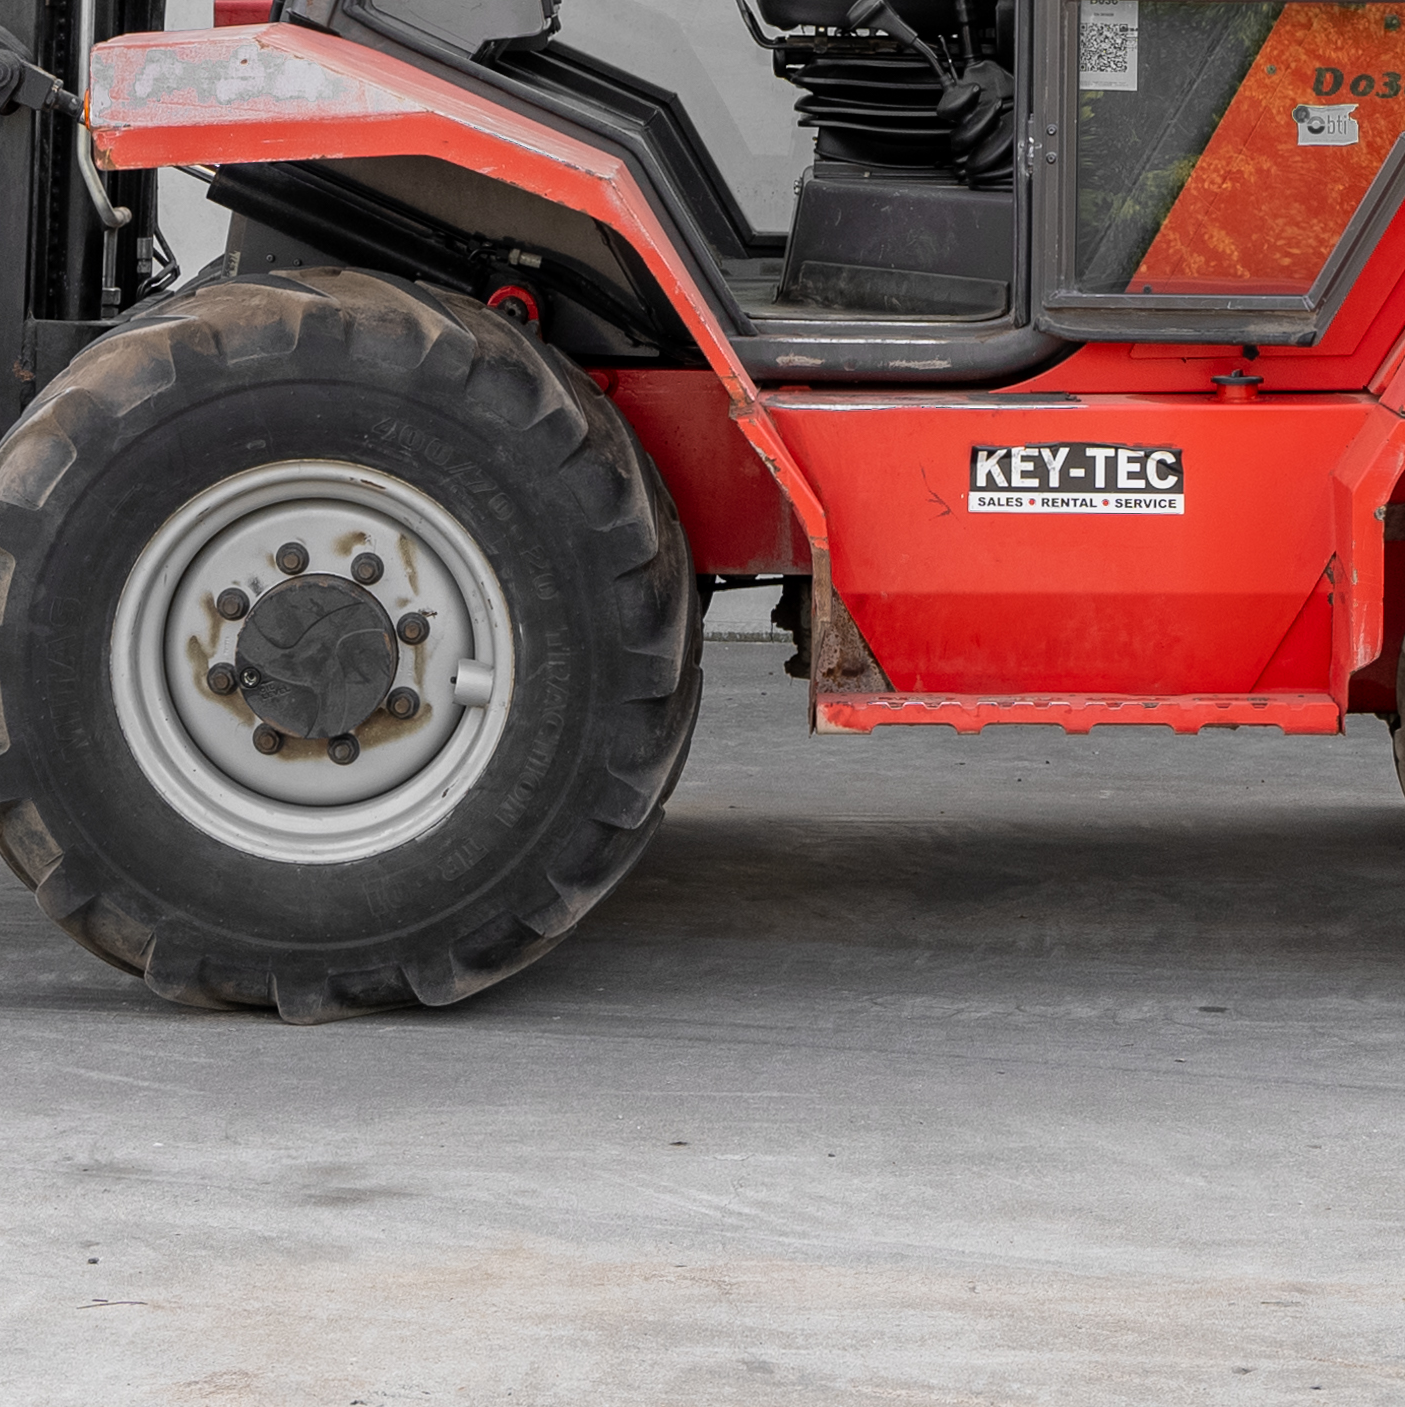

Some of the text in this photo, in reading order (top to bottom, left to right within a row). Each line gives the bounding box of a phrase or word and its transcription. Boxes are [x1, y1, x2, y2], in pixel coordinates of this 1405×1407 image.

[1327, 114, 1347, 135] bti
[975, 446, 1179, 490] KEY-TEC
[977, 496, 1177, 510] SALES RENTAL SERVICE
